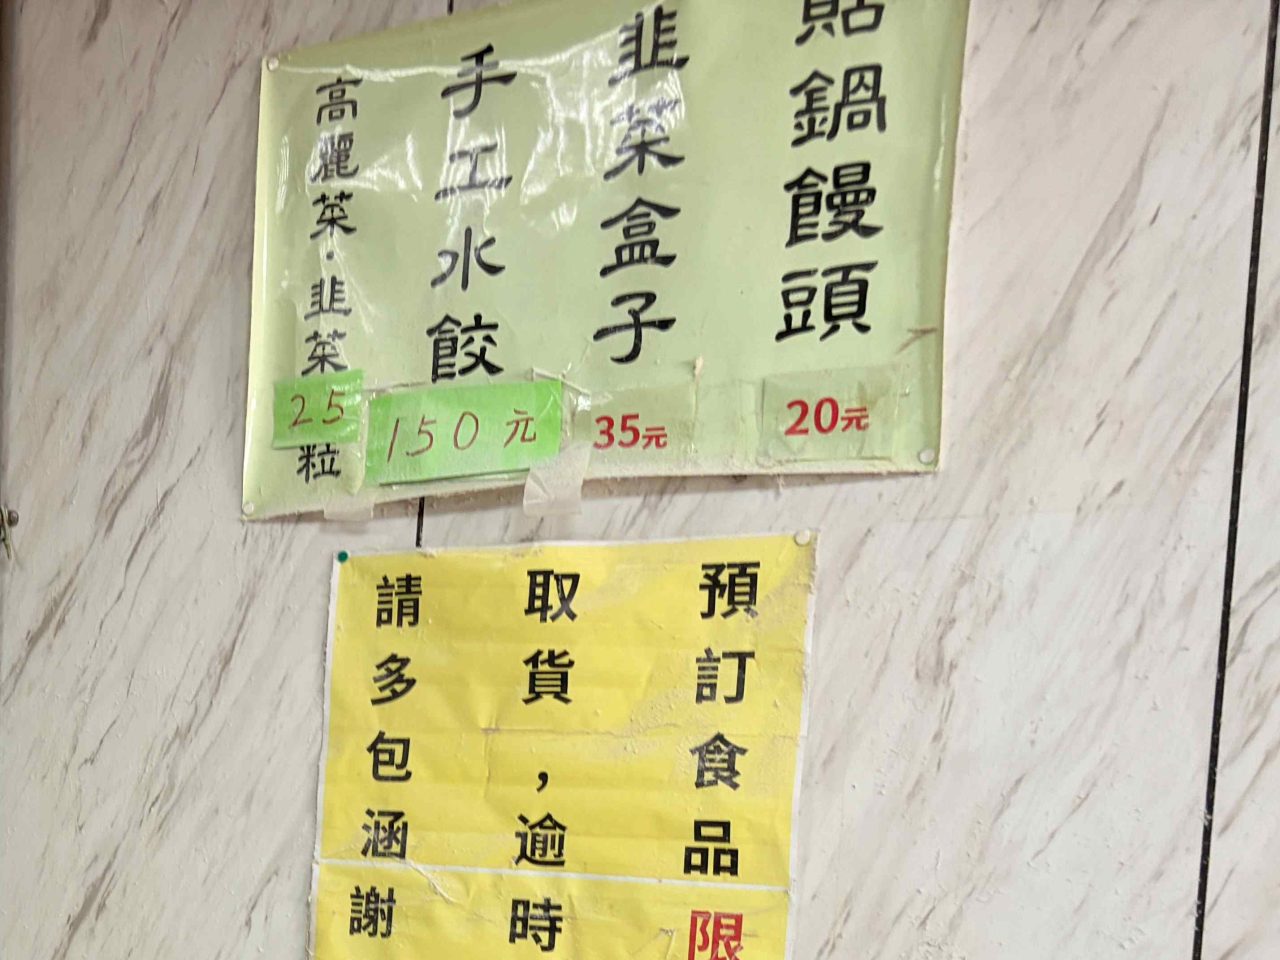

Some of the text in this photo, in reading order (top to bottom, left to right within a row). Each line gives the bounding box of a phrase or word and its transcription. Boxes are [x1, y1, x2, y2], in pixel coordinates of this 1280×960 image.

[592, 4, 690, 364] 韭菜盒子
[426, 43, 517, 383] 手工水餃
[288, 388, 346, 428] 25
[784, 396, 870, 437] 20元
[593, 412, 669, 450] 35元
[296, 442, 341, 484] 粒
